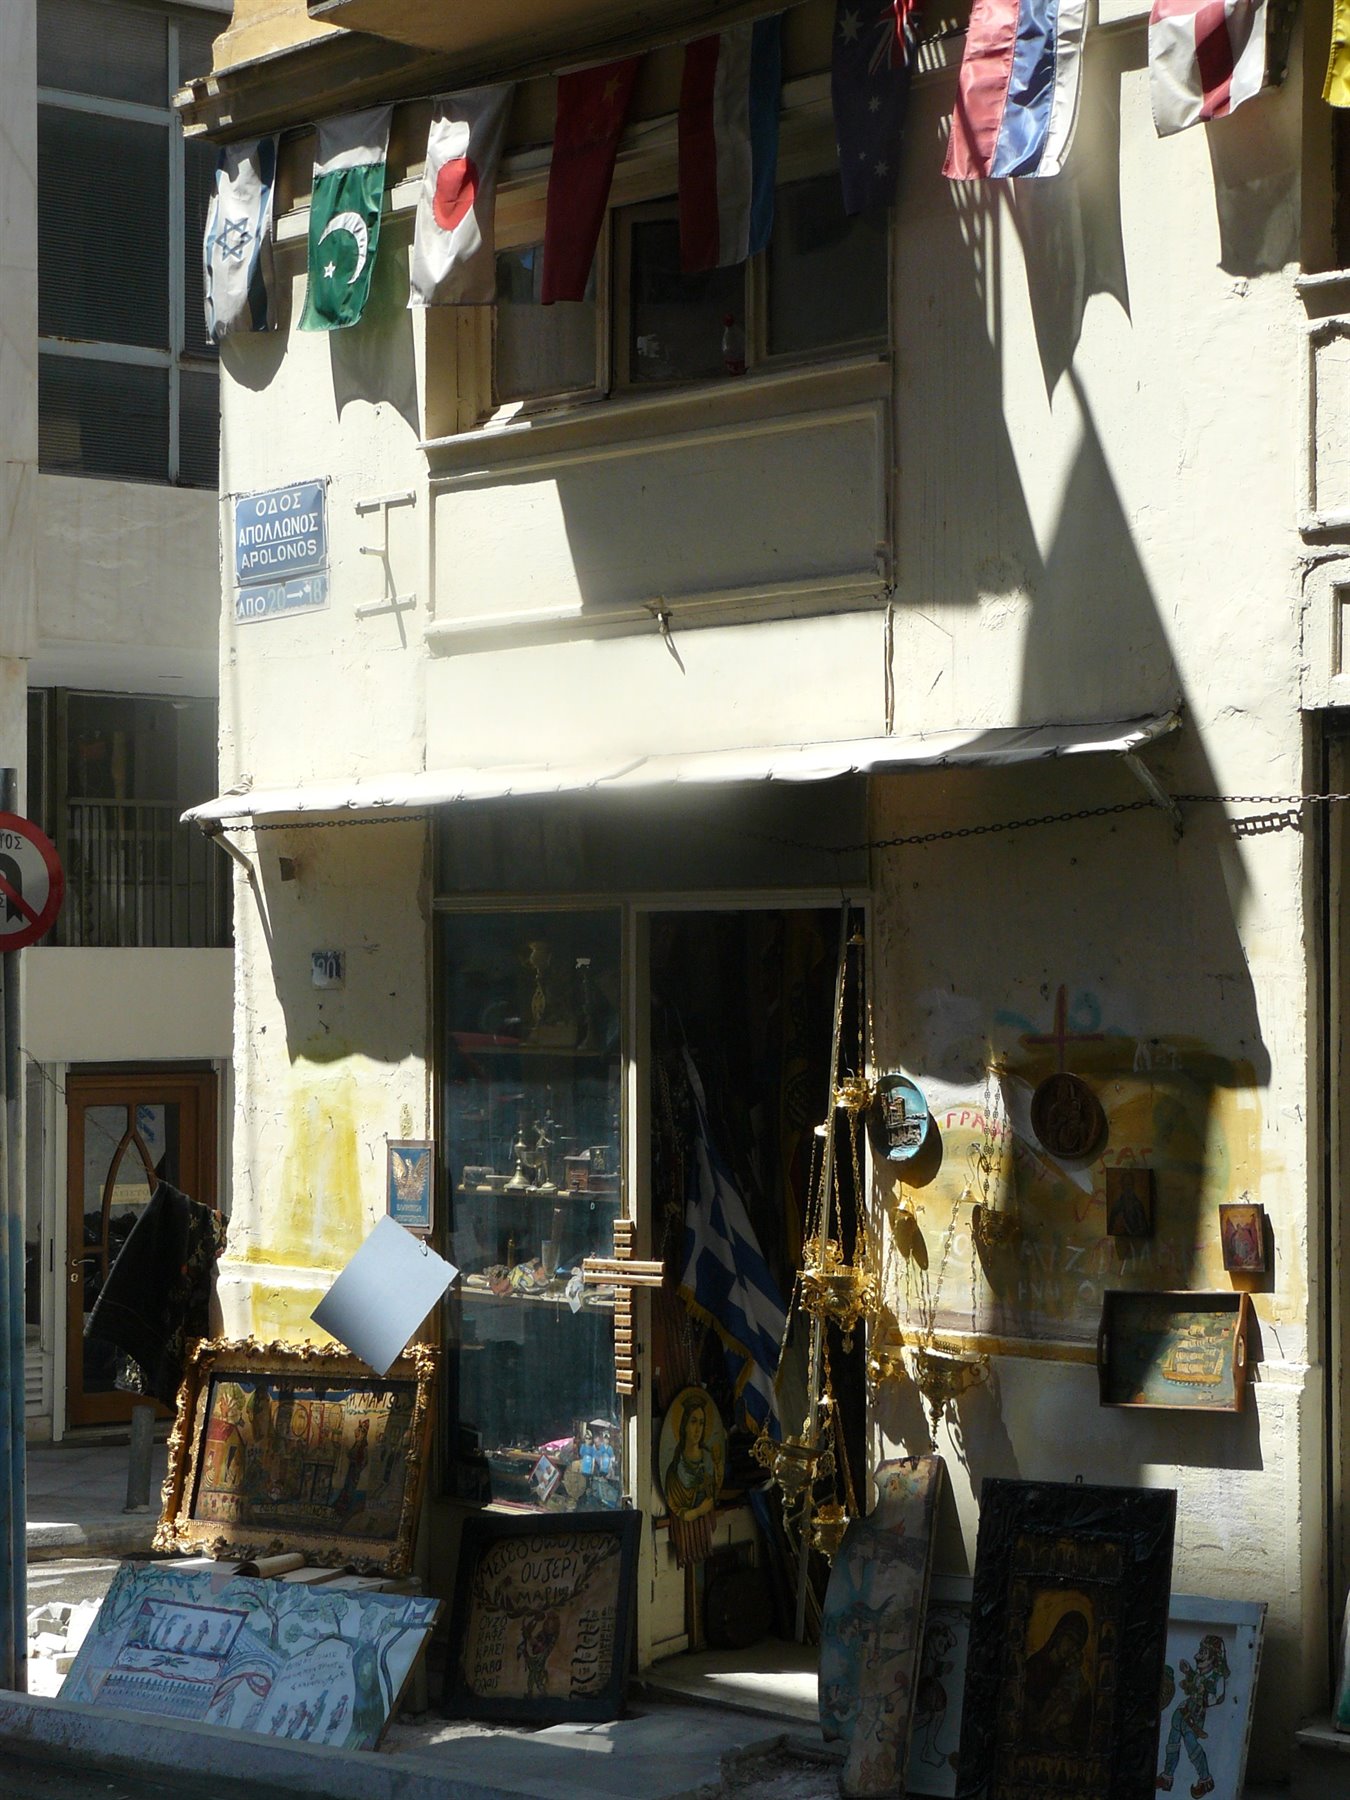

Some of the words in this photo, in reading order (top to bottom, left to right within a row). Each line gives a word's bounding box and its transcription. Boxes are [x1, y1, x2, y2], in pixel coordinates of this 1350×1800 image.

[255, 492, 302, 517] ΟΔΟΣ
[238, 513, 319, 548] ΑΠΟΛΛΩΝΟΣ
[241, 538, 318, 569] APOLONOS
[238, 596, 266, 618] ΑΠΟ
